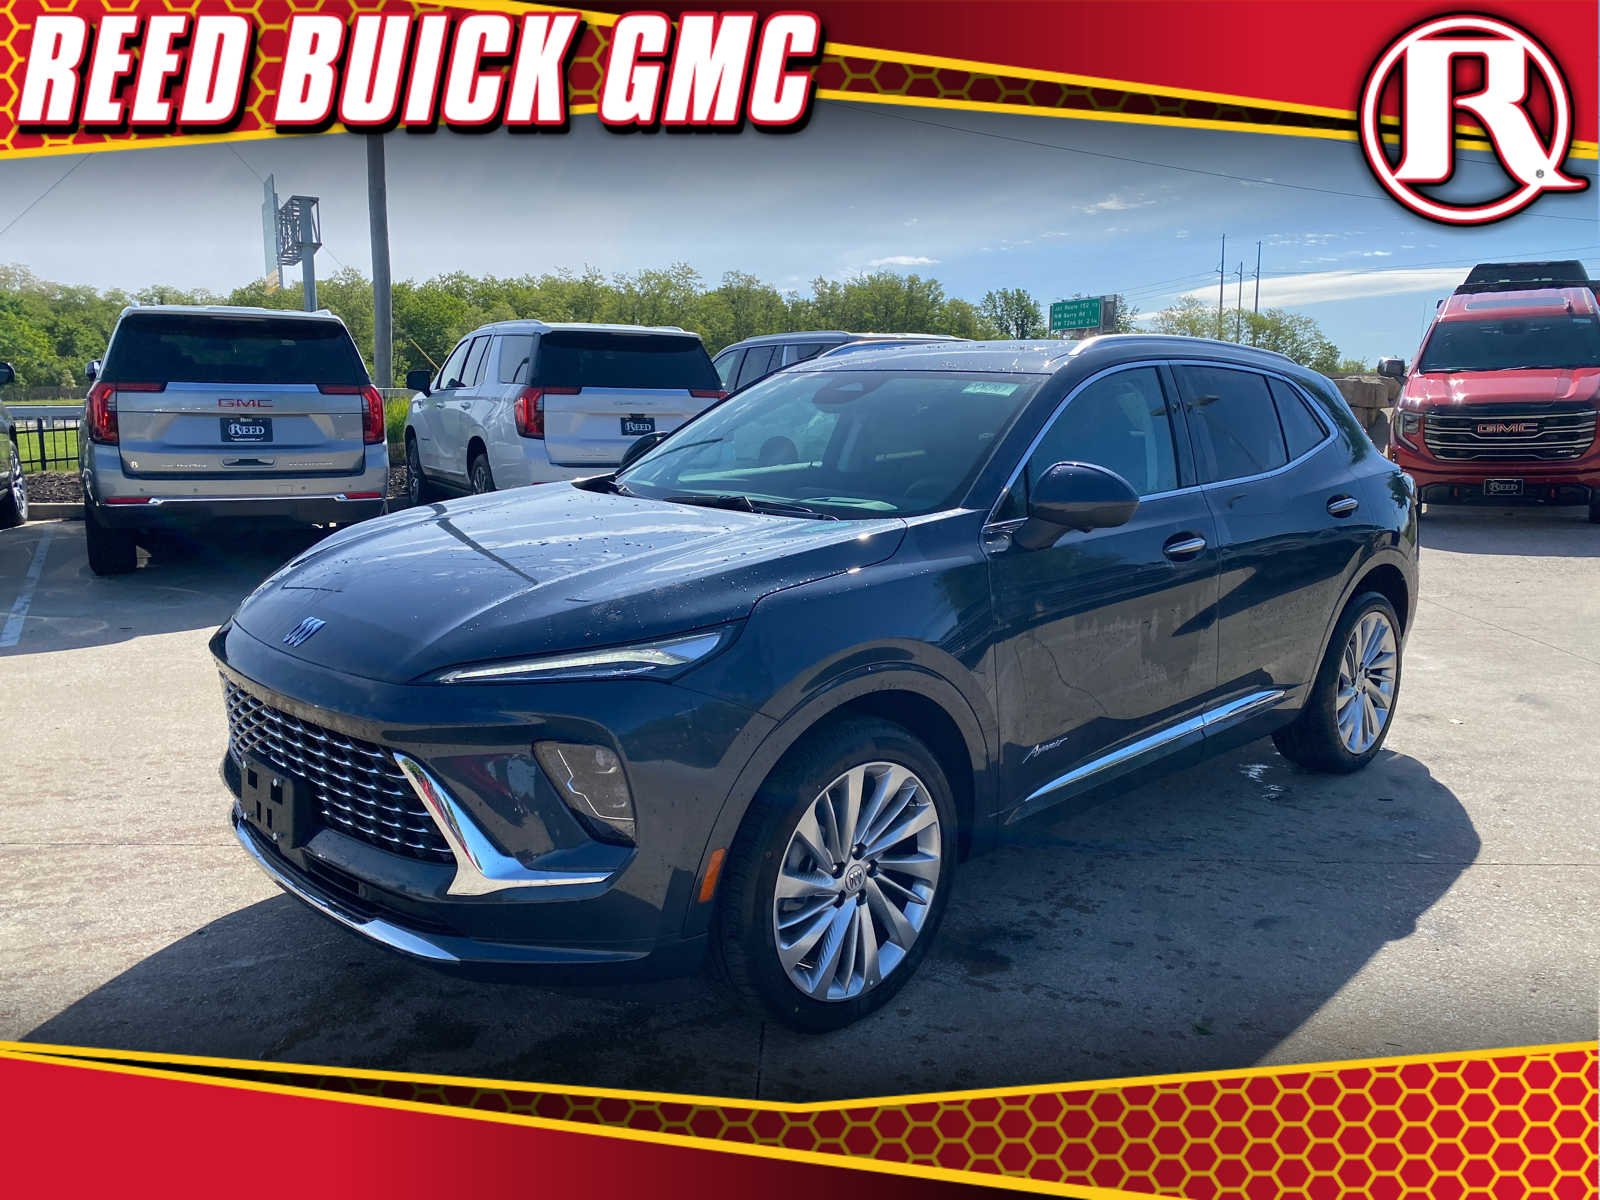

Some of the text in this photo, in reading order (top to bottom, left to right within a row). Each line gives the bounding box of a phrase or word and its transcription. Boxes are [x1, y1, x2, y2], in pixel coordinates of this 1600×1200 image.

[218, 399, 274, 407] GMC
[228, 423, 265, 437] REED
[625, 421, 651, 432] REED
[1477, 422, 1538, 433] GMC
[1489, 482, 1518, 491] REED
